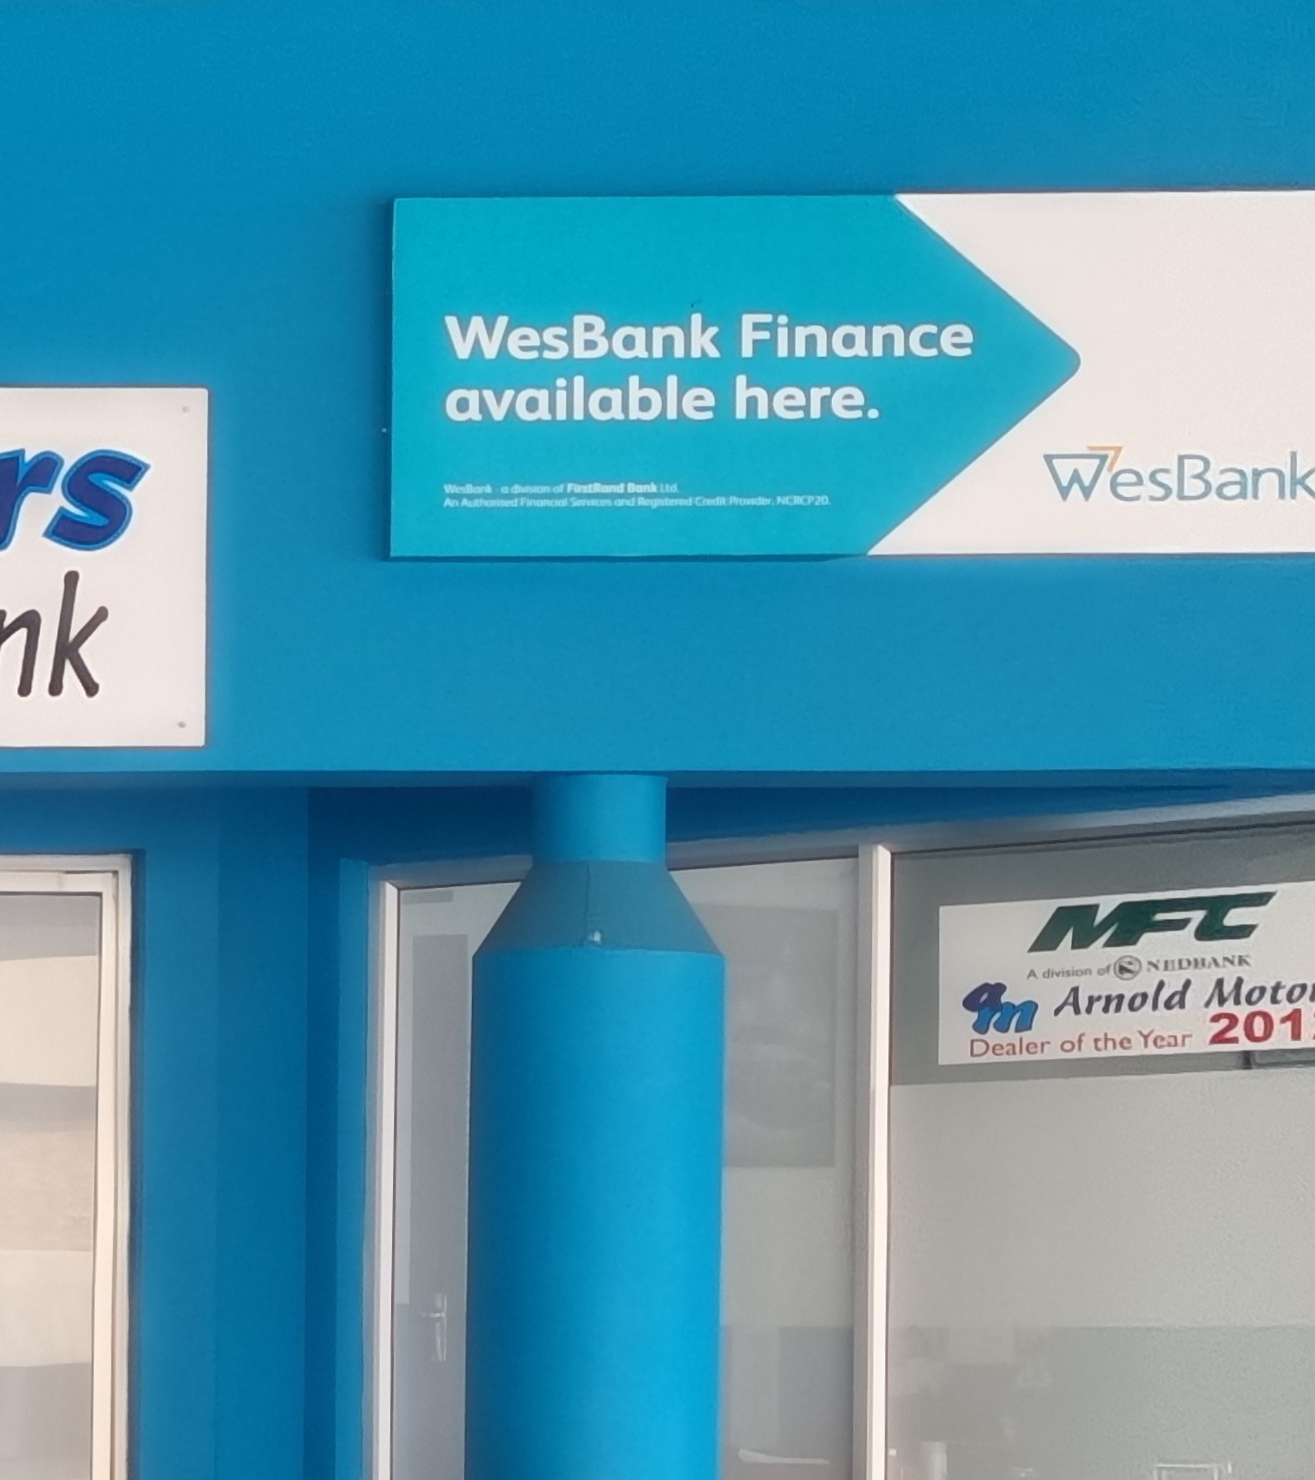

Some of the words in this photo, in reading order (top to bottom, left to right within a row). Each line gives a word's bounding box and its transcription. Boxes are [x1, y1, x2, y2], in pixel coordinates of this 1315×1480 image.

[444, 314, 721, 361] WesBank
[740, 314, 975, 358] Finance
[445, 375, 716, 422] available
[735, 376, 880, 421] here.
[567, 482, 625, 494] FirstRand
[627, 482, 658, 494] Bank
[1043, 446, 1315, 502] WesBank
[520, 497, 568, 508] Financial
[570, 496, 612, 507] Services
[614, 496, 635, 507] and
[638, 496, 692, 510] Registered
[1027, 890, 1278, 954] MFC
[1027, 968, 1039, 981] A
[1042, 965, 1093, 980] division
[1097, 963, 1112, 977] of
[1054, 978, 1193, 1017] Arnold
[969, 1037, 1051, 1059] Dealer
[1060, 1033, 1086, 1054] of
[1093, 1032, 1133, 1053] the
[1138, 1028, 1193, 1050] Year
[1208, 1008, 1315, 1046] 201
